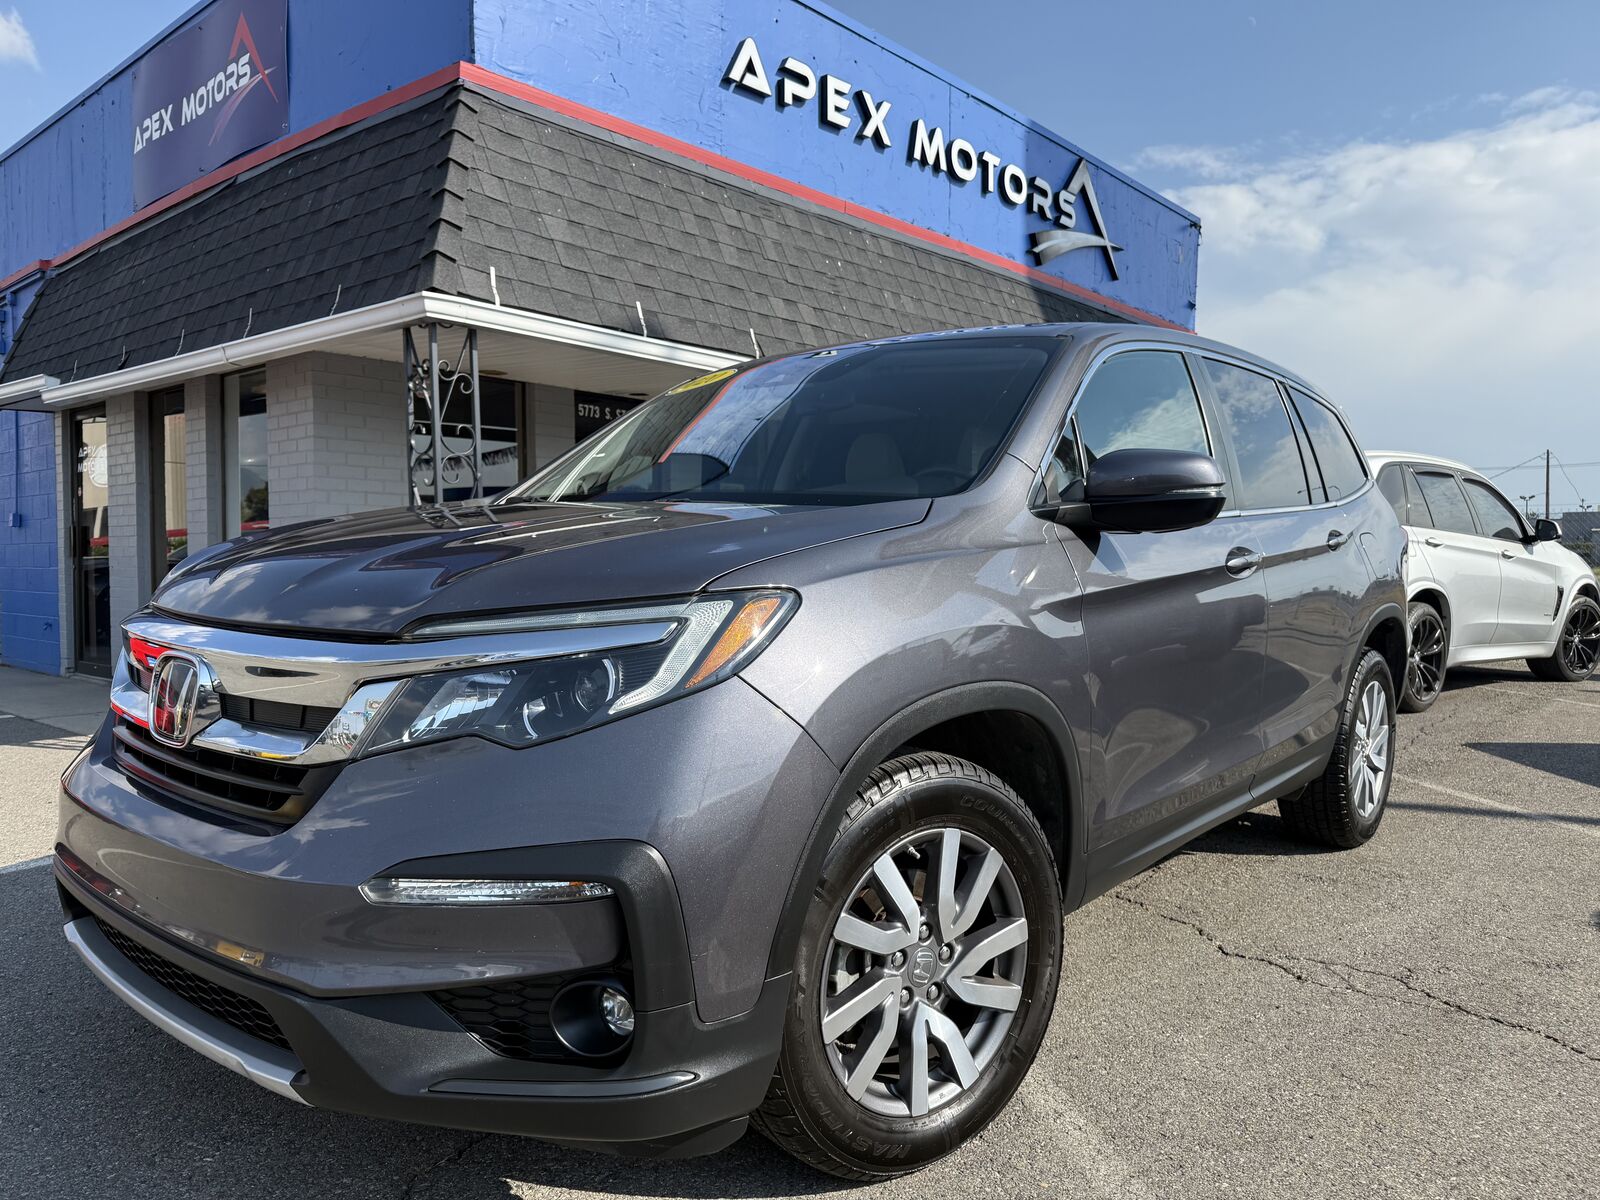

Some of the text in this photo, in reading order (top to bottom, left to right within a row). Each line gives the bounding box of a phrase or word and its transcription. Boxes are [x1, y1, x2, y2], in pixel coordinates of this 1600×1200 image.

[134, 53, 250, 154] APEX MOTORS
[724, 36, 1078, 229] APEX MOTORS
[577, 403, 600, 418] 5773
